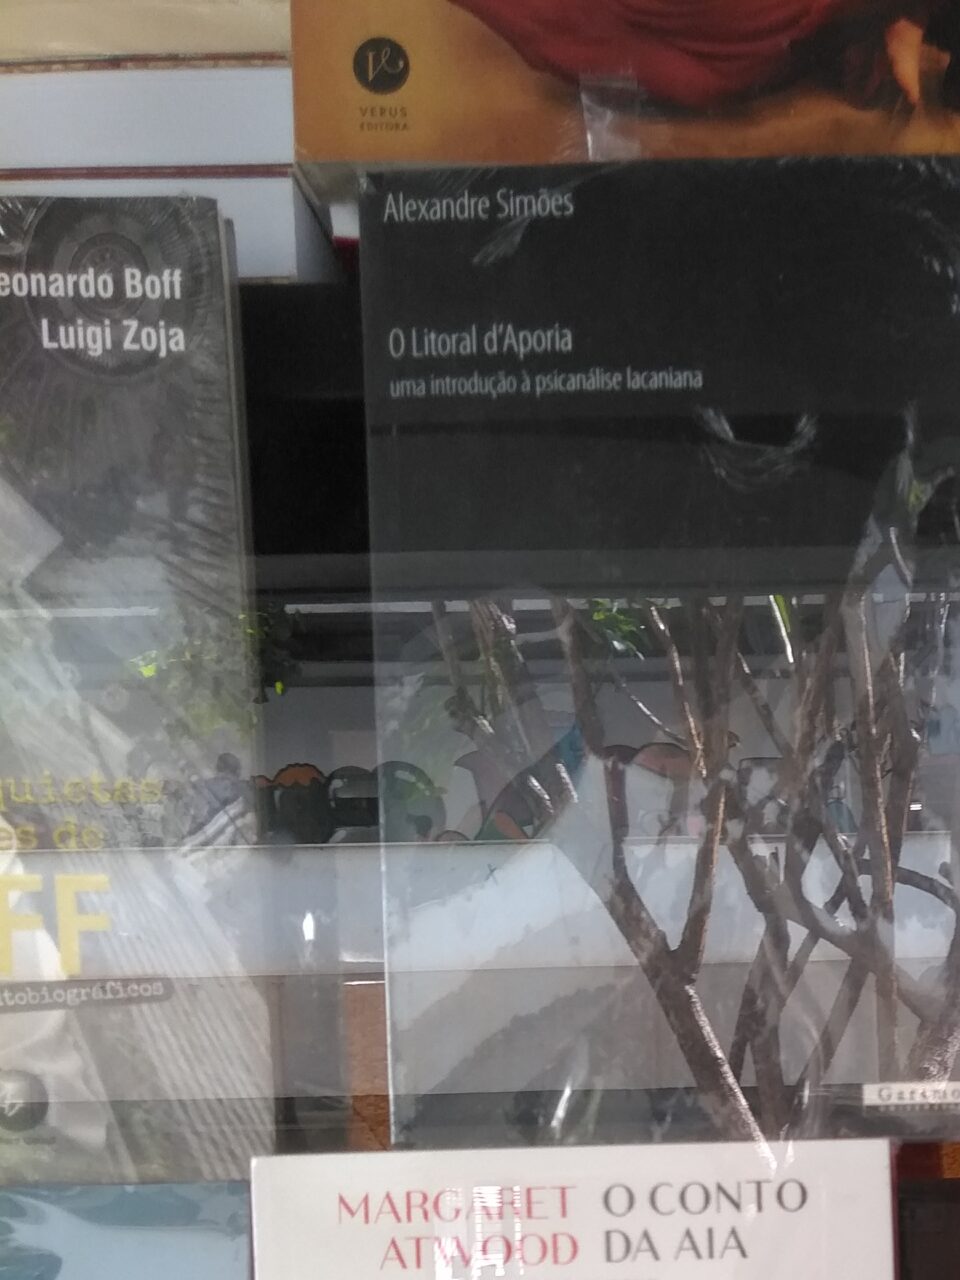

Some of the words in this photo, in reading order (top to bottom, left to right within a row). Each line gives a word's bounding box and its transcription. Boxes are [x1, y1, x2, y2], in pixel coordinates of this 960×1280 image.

[383, 192, 490, 223] Alexandre
[496, 188, 574, 219] Simões
[125, 267, 182, 299] Boff
[41, 318, 112, 357] Luigi
[122, 319, 186, 358] Zoja
[389, 327, 405, 359] O
[411, 323, 477, 358] Litoral
[390, 377, 426, 399] uma
[430, 371, 517, 398] introdução
[535, 367, 622, 397] psicanálise
[626, 366, 703, 391] lacaniana
[0, 982, 164, 1005] tobiográficos
[338, 1185, 578, 1225] MARGARET
[603, 1183, 635, 1217] O
[649, 1178, 808, 1216] CONTO
[604, 1229, 660, 1263] DA
[674, 1226, 749, 1260] AIA
